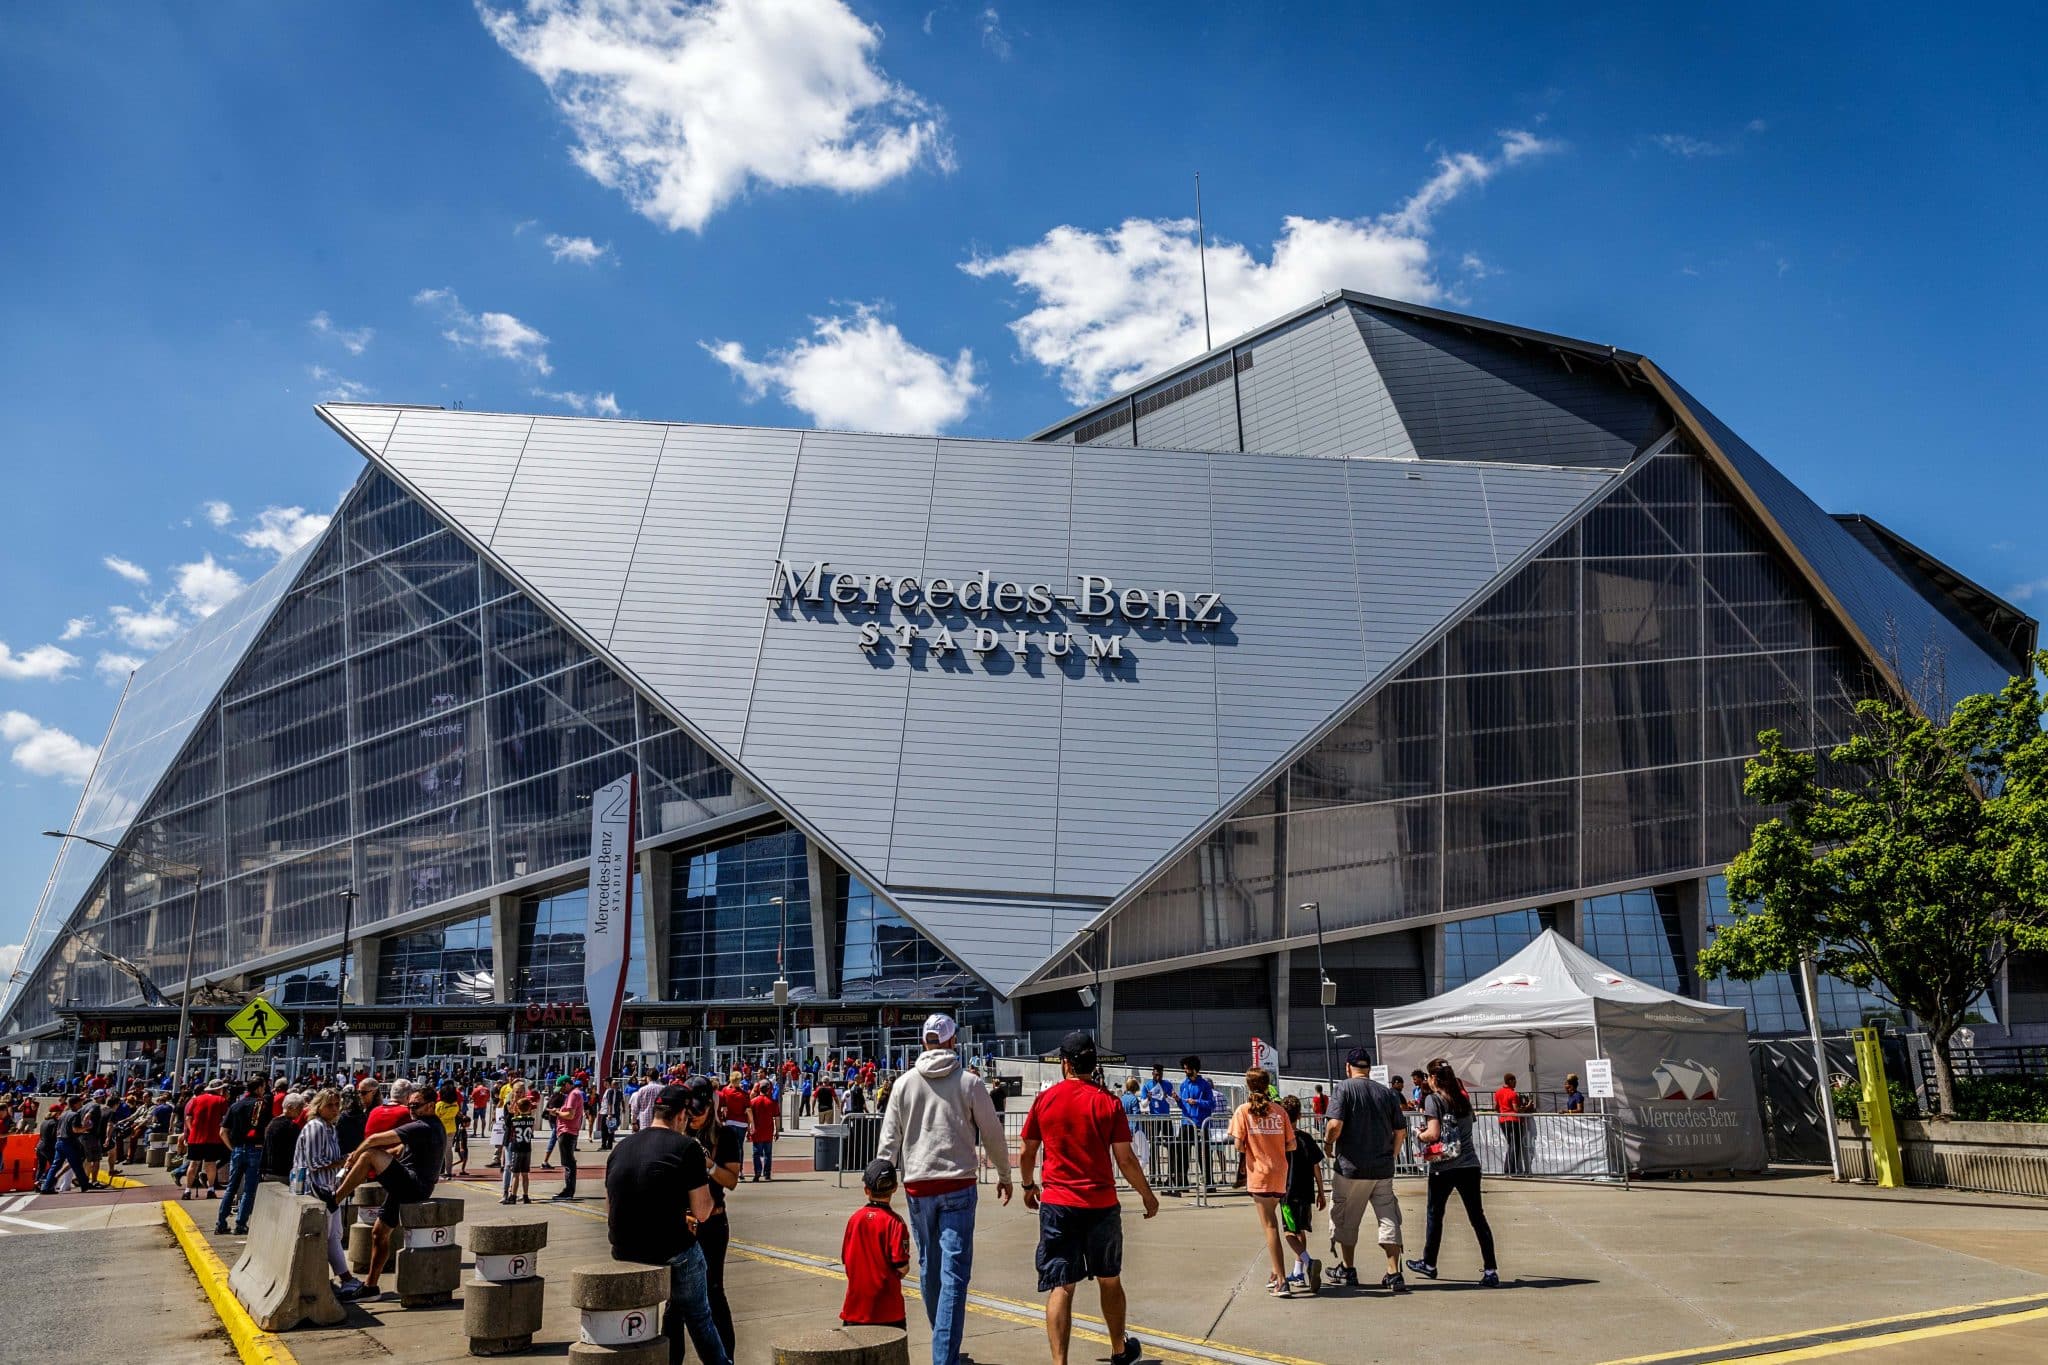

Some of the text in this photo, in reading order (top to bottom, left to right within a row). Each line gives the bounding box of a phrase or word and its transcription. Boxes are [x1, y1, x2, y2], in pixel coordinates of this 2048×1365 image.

[768, 558, 1222, 626] Mercedes-Benz
[858, 620, 1123, 661] STADIUM
[421, 723, 464, 738] WELCOME
[594, 831, 612, 935] Mercedes-Benz
[612, 853, 622, 912] STADIUM
[526, 1002, 584, 1023] GATE
[731, 1015, 780, 1024] ATLANTA UNITE
[111, 1023, 179, 1035] ATLANTA UNITED
[368, 1021, 396, 1030] UNITED
[1640, 1106, 1739, 1128] Mercedes-Benz
[515, 1127, 532, 1143] 30
[1667, 1133, 1723, 1146] STADIUM
[627, 1316, 642, 1337] P
